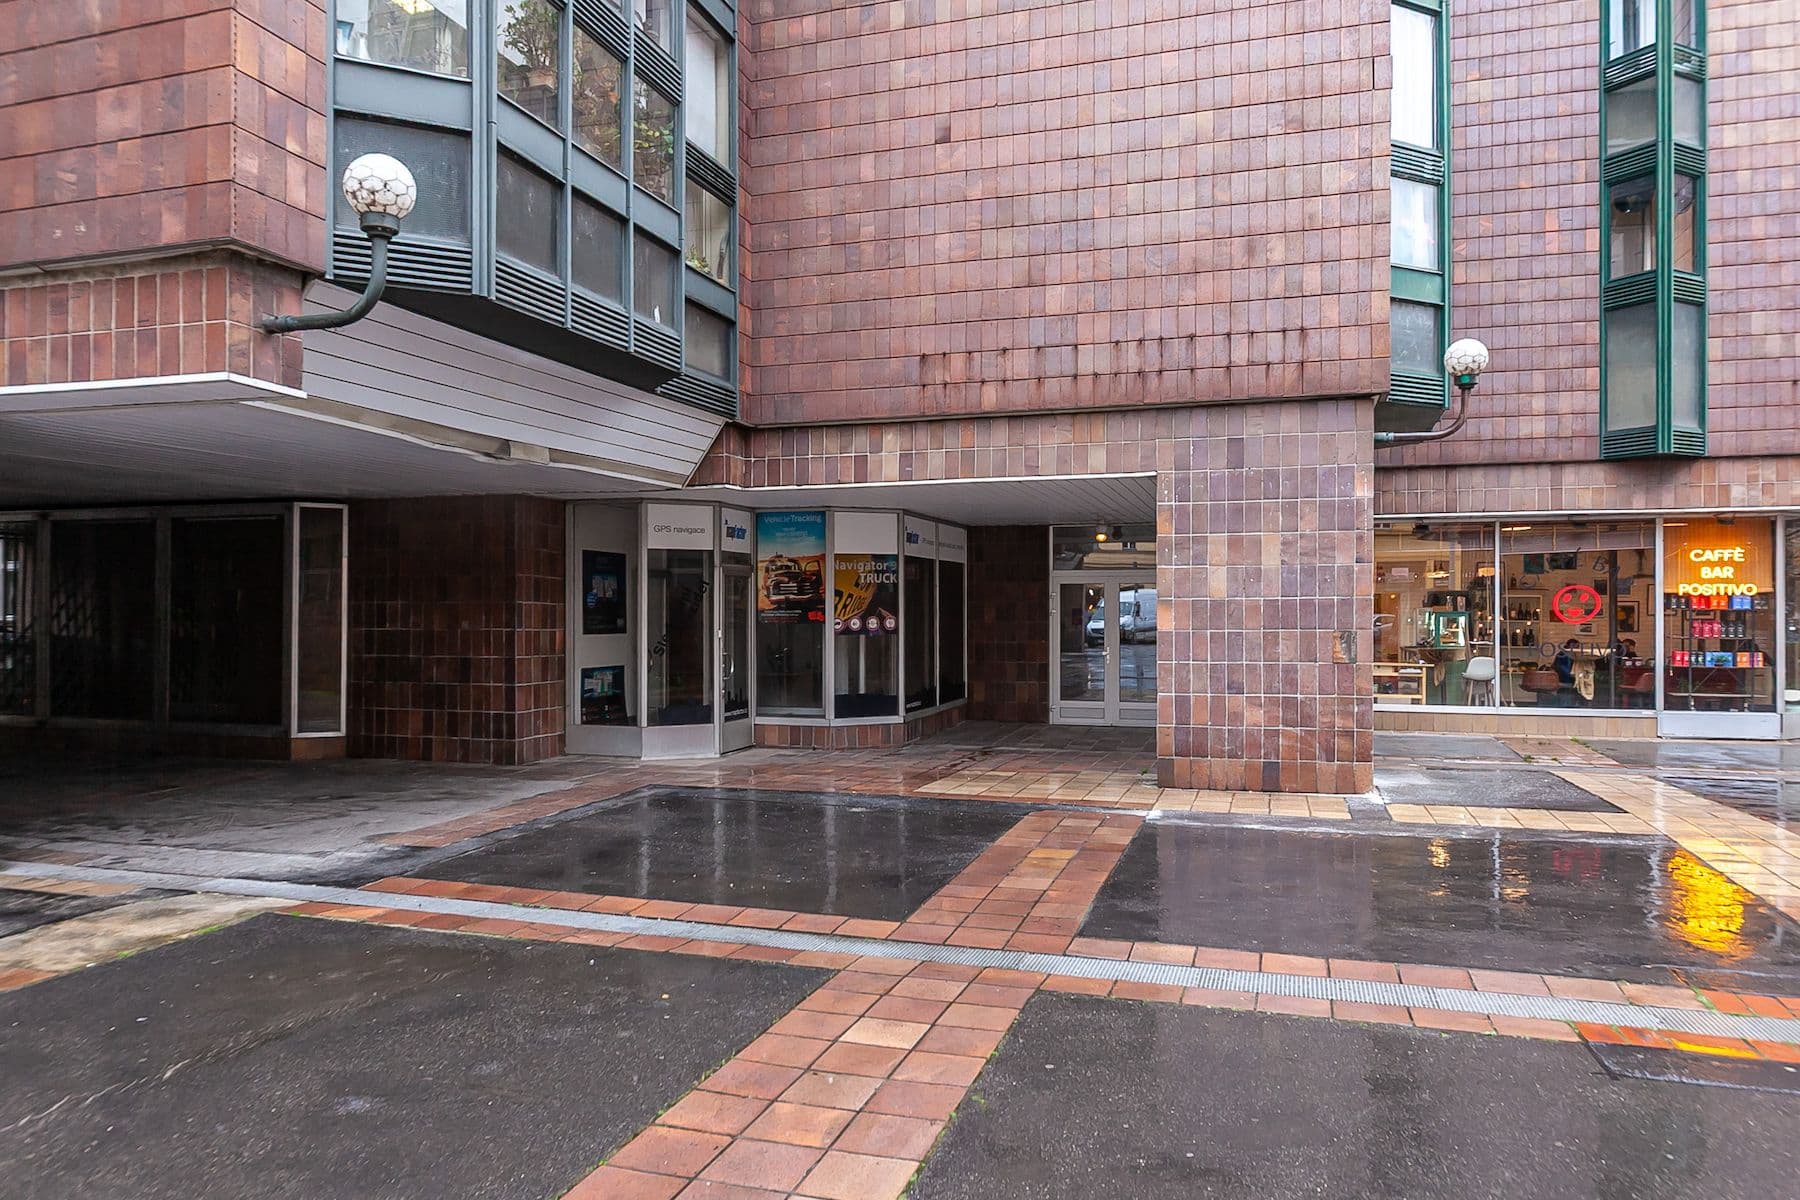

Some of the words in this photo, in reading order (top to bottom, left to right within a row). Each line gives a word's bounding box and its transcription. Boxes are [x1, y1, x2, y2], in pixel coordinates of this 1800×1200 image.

[653, 524, 672, 533] GPS
[673, 526, 706, 534] navigace
[1689, 546, 1746, 562] CAFFÈ
[834, 560, 888, 572] Navigator
[859, 573, 898, 583] TRUCK
[1700, 566, 1735, 579] BAR
[1678, 583, 1758, 596] POSITIVO
